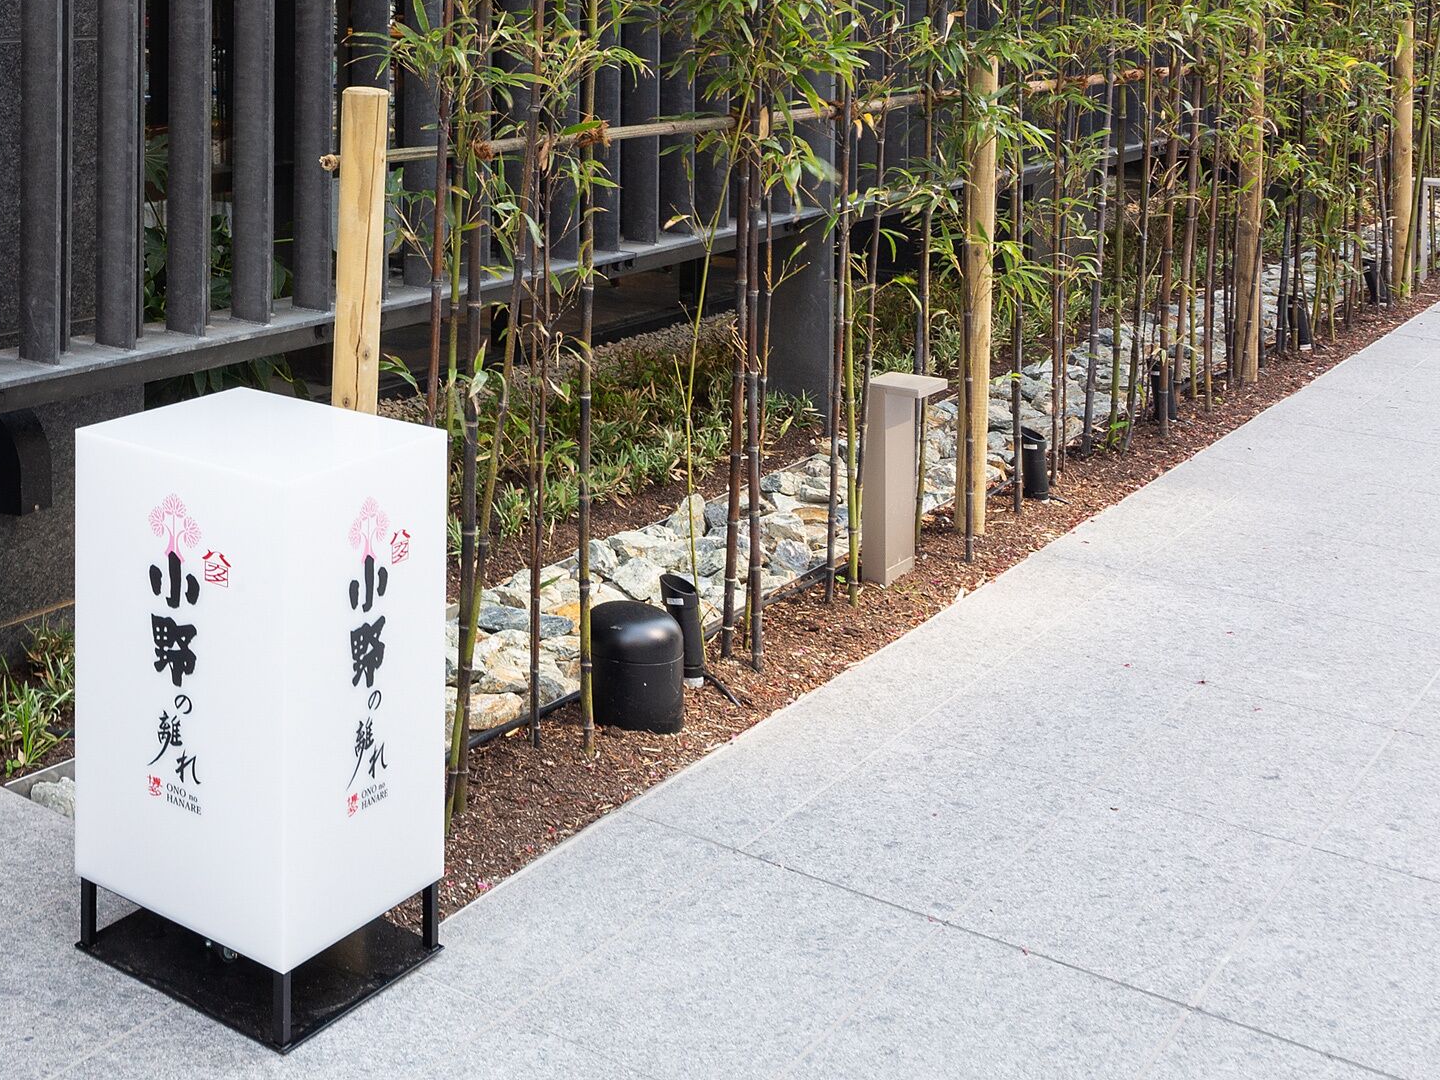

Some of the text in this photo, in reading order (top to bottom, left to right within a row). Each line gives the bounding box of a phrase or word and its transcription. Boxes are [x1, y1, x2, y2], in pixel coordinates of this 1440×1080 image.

[148, 551, 201, 784] 小野の離れ
[347, 555, 388, 790] 小野の離れ
[166, 783, 198, 803] ONO no
[361, 784, 377, 799] ONO
[361, 789, 388, 810] HANARE
[166, 793, 201, 815] HANARE
